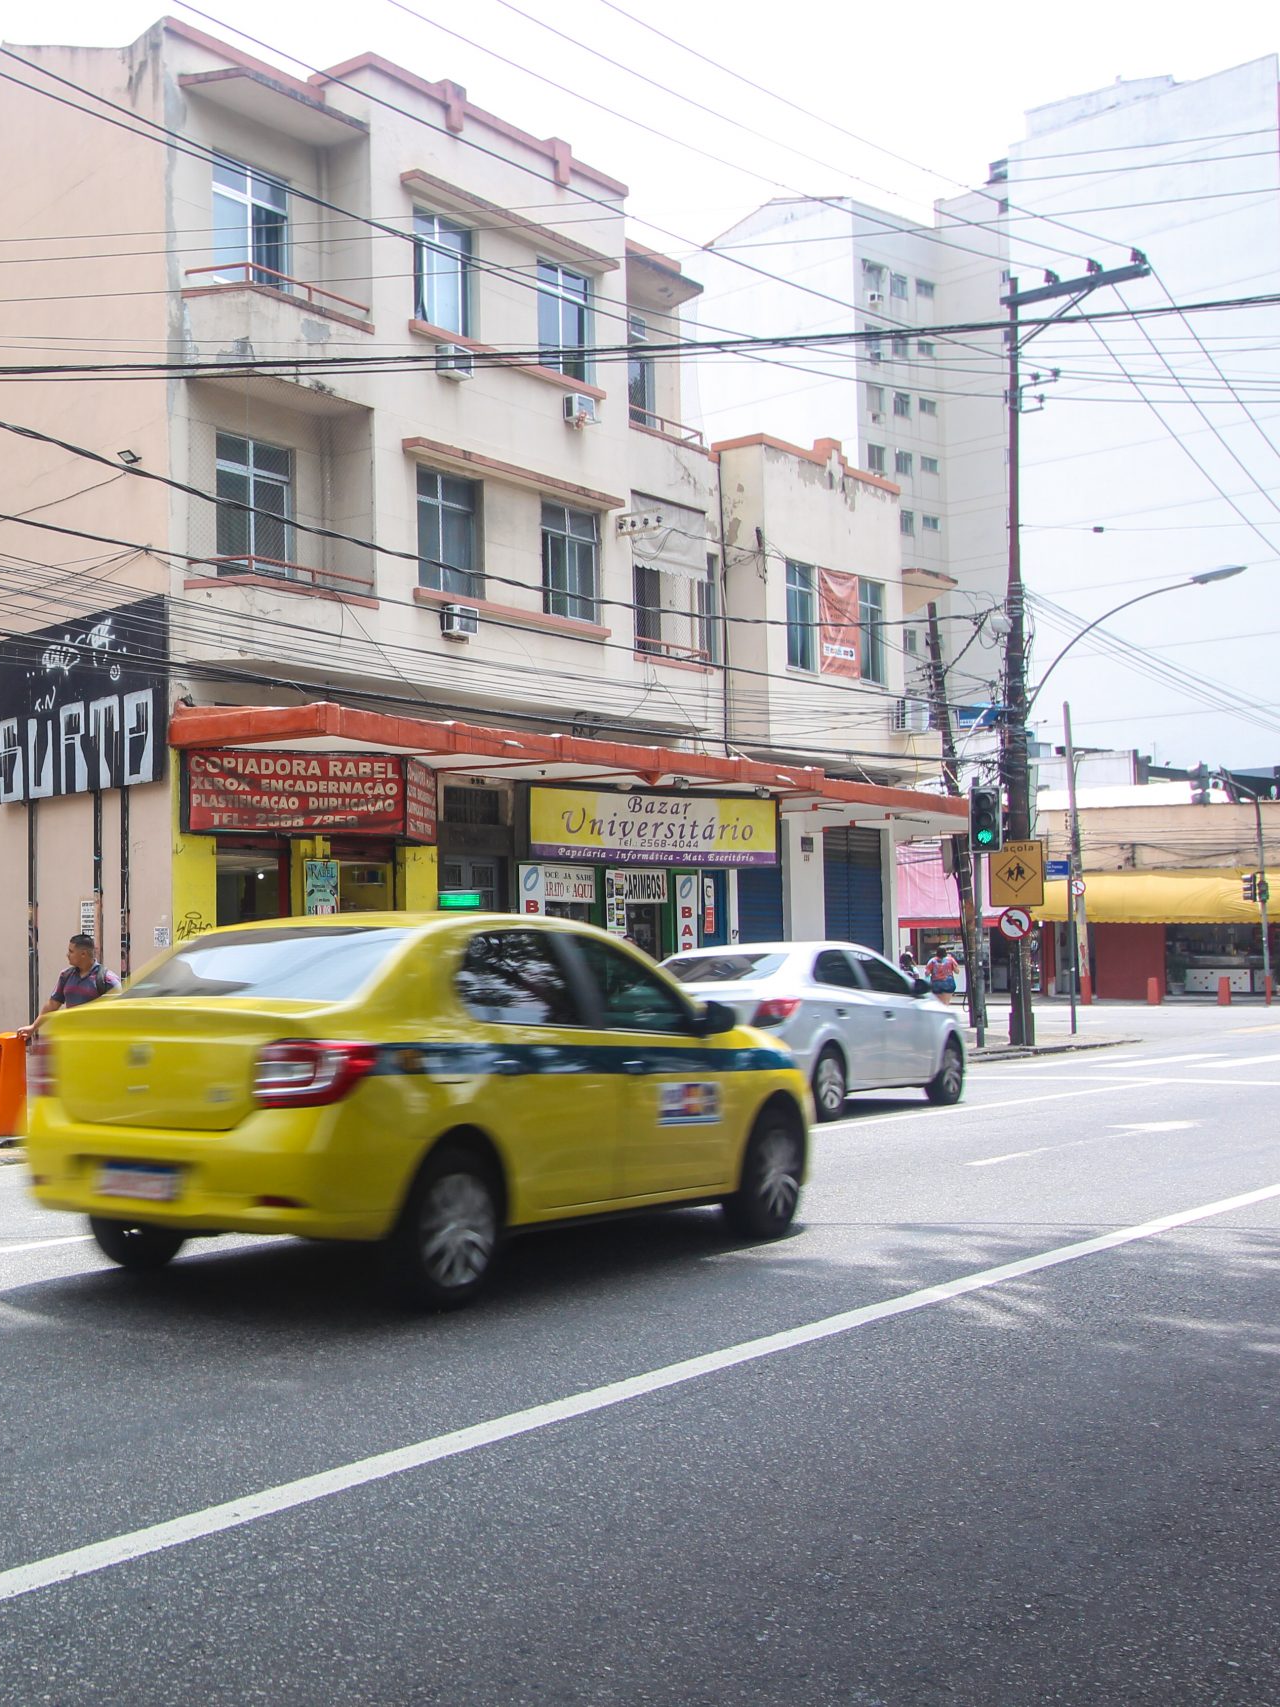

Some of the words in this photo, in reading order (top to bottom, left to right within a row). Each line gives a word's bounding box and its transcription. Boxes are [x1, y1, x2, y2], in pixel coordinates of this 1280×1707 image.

[191, 755, 321, 777] COPIADORA
[328, 761, 399, 779] RABEL
[192, 776, 251, 792] XEROX
[261, 778, 399, 798] ENCADERNAÇÃO
[192, 793, 299, 812] PLASTIFICAÇÃO
[308, 795, 395, 816] DUPLICAÇÃO
[627, 795, 693, 816] Bazar
[211, 813, 249, 827] TEL:
[561, 808, 754, 842] Universitário
[640, 838, 699, 849] 2568-4044
[1000, 843, 1034, 853] scola
[557, 847, 606, 860] Papelaria
[615, 850, 674, 863] Informática
[682, 853, 705, 863] Mat.
[707, 854, 754, 864] Escritório
[572, 883, 593, 899] AQUI
